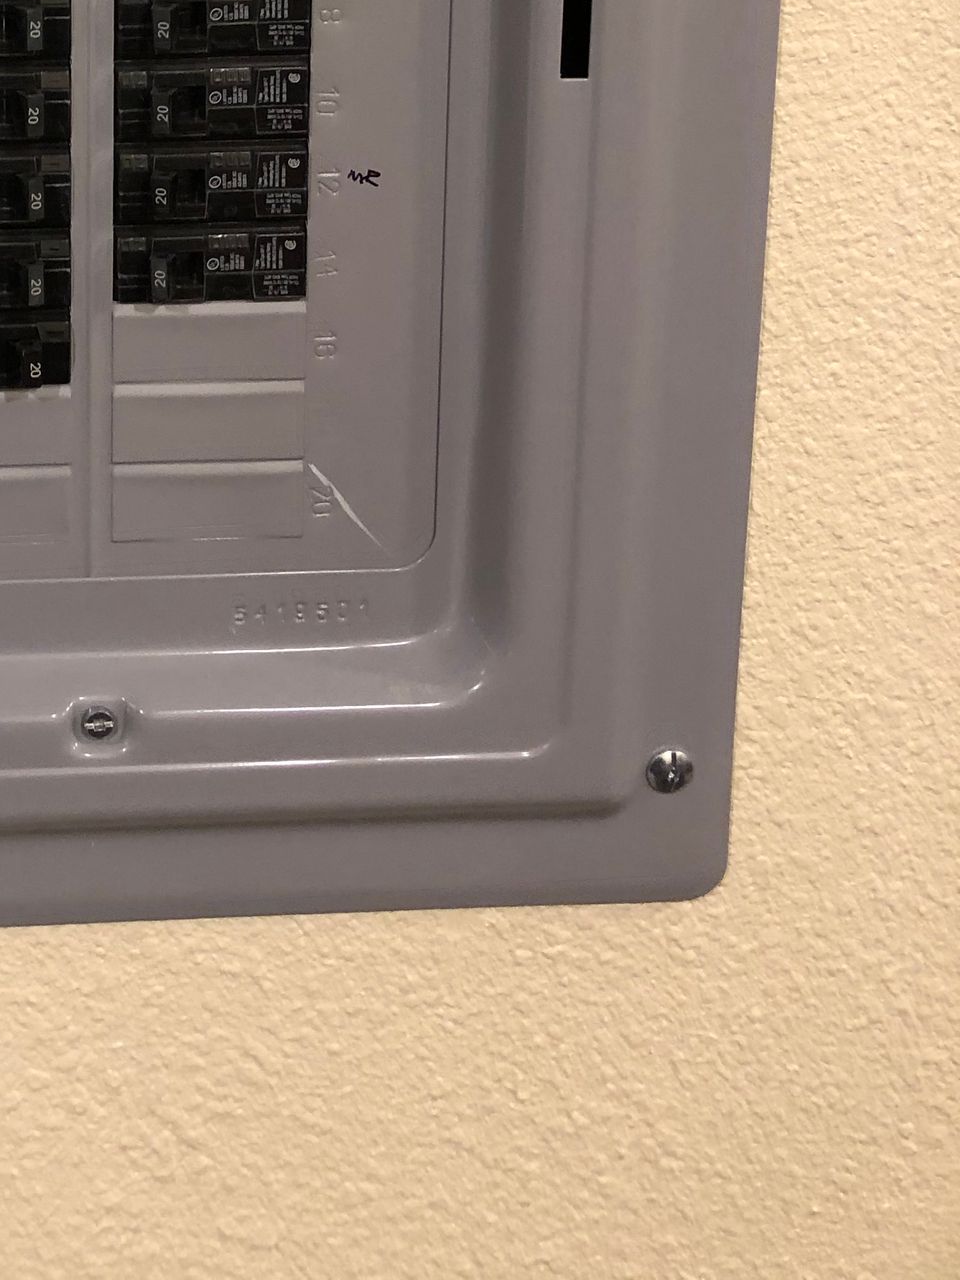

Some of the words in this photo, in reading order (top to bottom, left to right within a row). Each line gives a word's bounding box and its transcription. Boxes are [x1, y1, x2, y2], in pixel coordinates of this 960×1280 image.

[30, 21, 41, 39] 20
[158, 21, 170, 39] 20
[316, 87, 340, 117] 10
[28, 107, 40, 125] 20
[157, 105, 169, 122] 20
[317, 167, 341, 197] 12
[30, 193, 42, 210] 20
[155, 188, 167, 205] 20
[30, 279, 42, 296] 20
[155, 270, 166, 288] 20
[30, 362, 41, 379] 20
